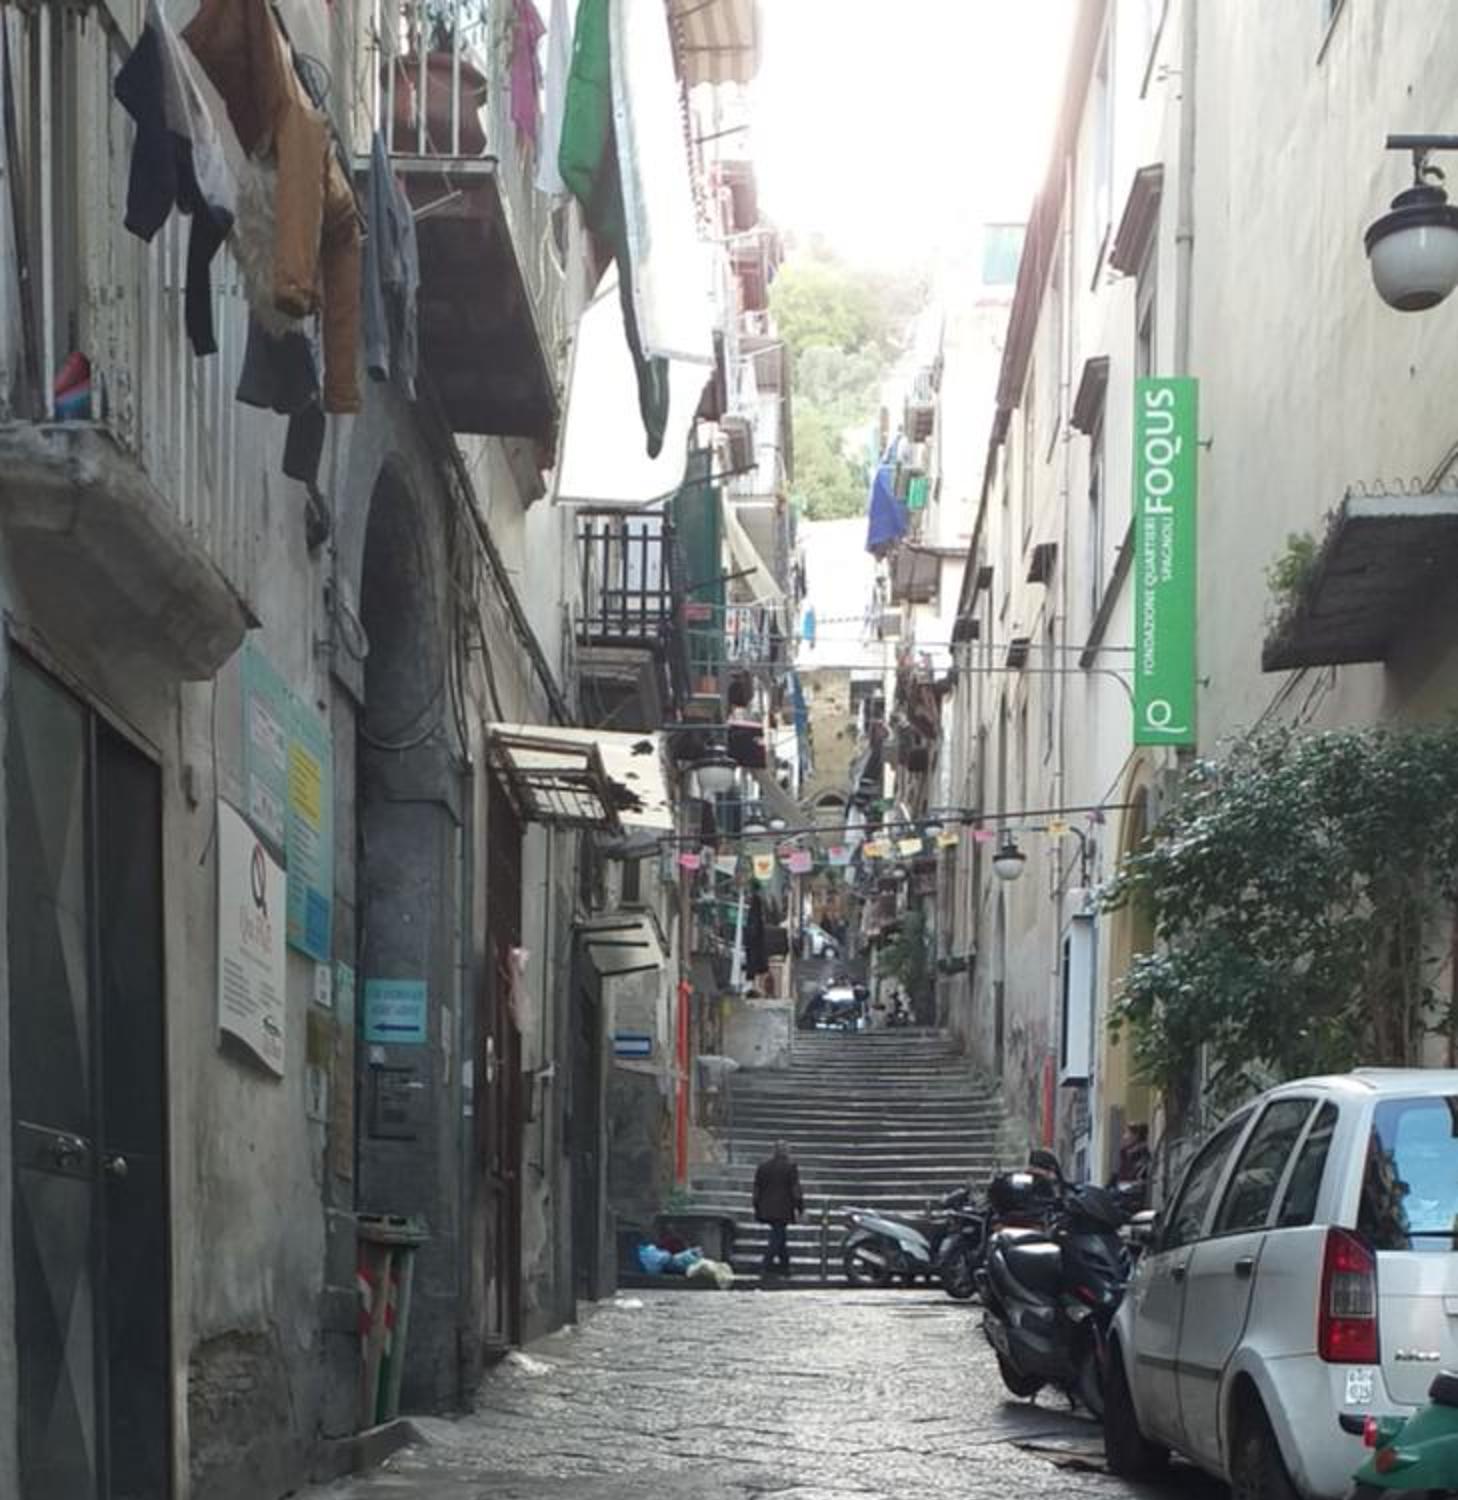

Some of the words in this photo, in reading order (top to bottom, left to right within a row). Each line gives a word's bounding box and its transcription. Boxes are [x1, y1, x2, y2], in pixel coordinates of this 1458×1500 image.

[1145, 388, 1181, 513] FOQUS
[1144, 516, 1158, 586] QUARTIERI
[1161, 515, 1173, 582] SPAGNOLI
[1143, 590, 1155, 675] FONDAZIONE
